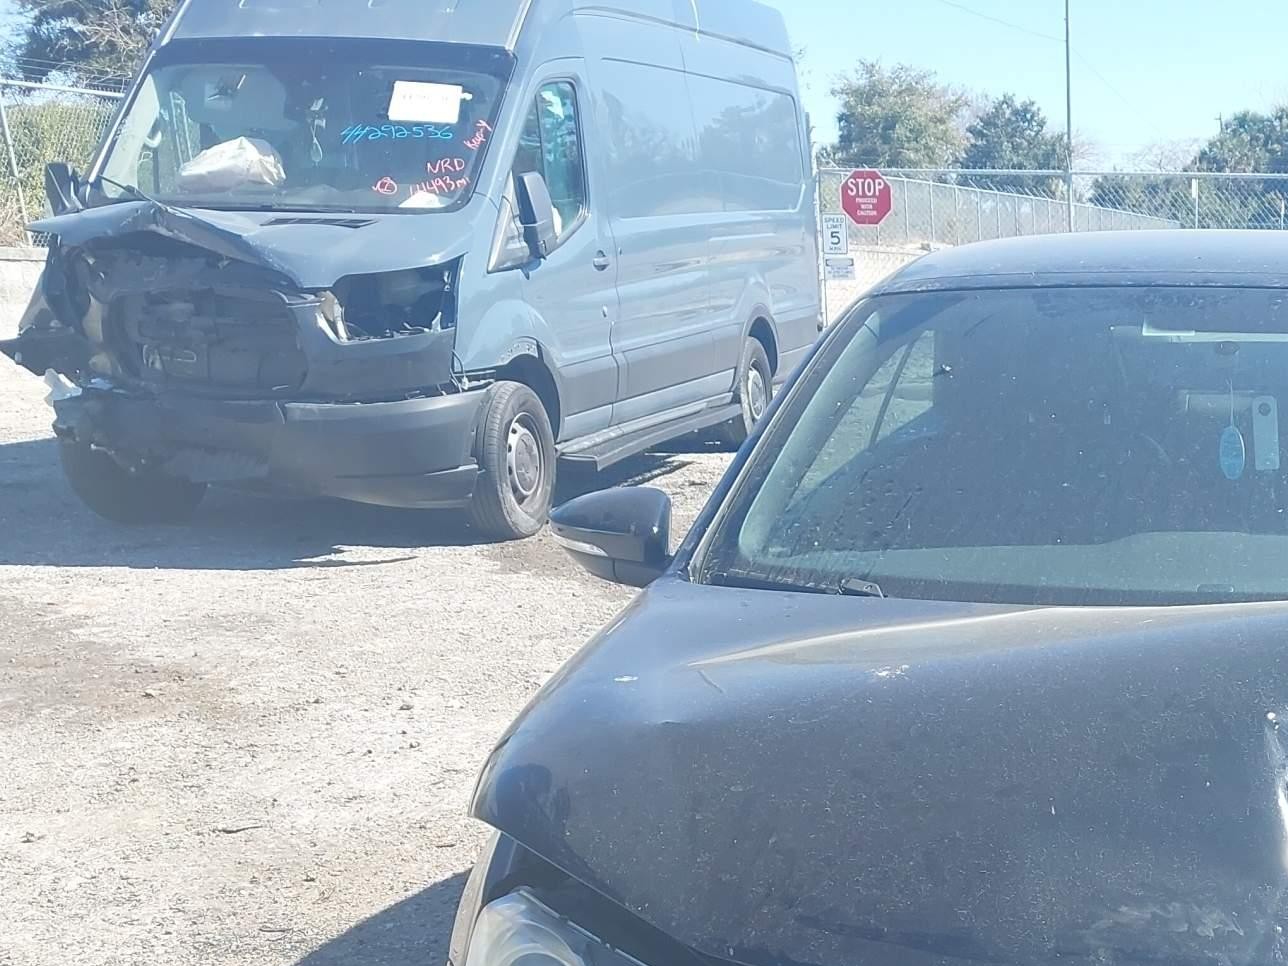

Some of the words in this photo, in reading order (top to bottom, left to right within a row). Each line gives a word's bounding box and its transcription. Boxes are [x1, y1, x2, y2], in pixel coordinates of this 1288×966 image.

[340, 124, 454, 144] 44292536
[426, 158, 466, 174] NRD
[847, 178, 884, 196] STOP
[830, 231, 841, 246] 5
